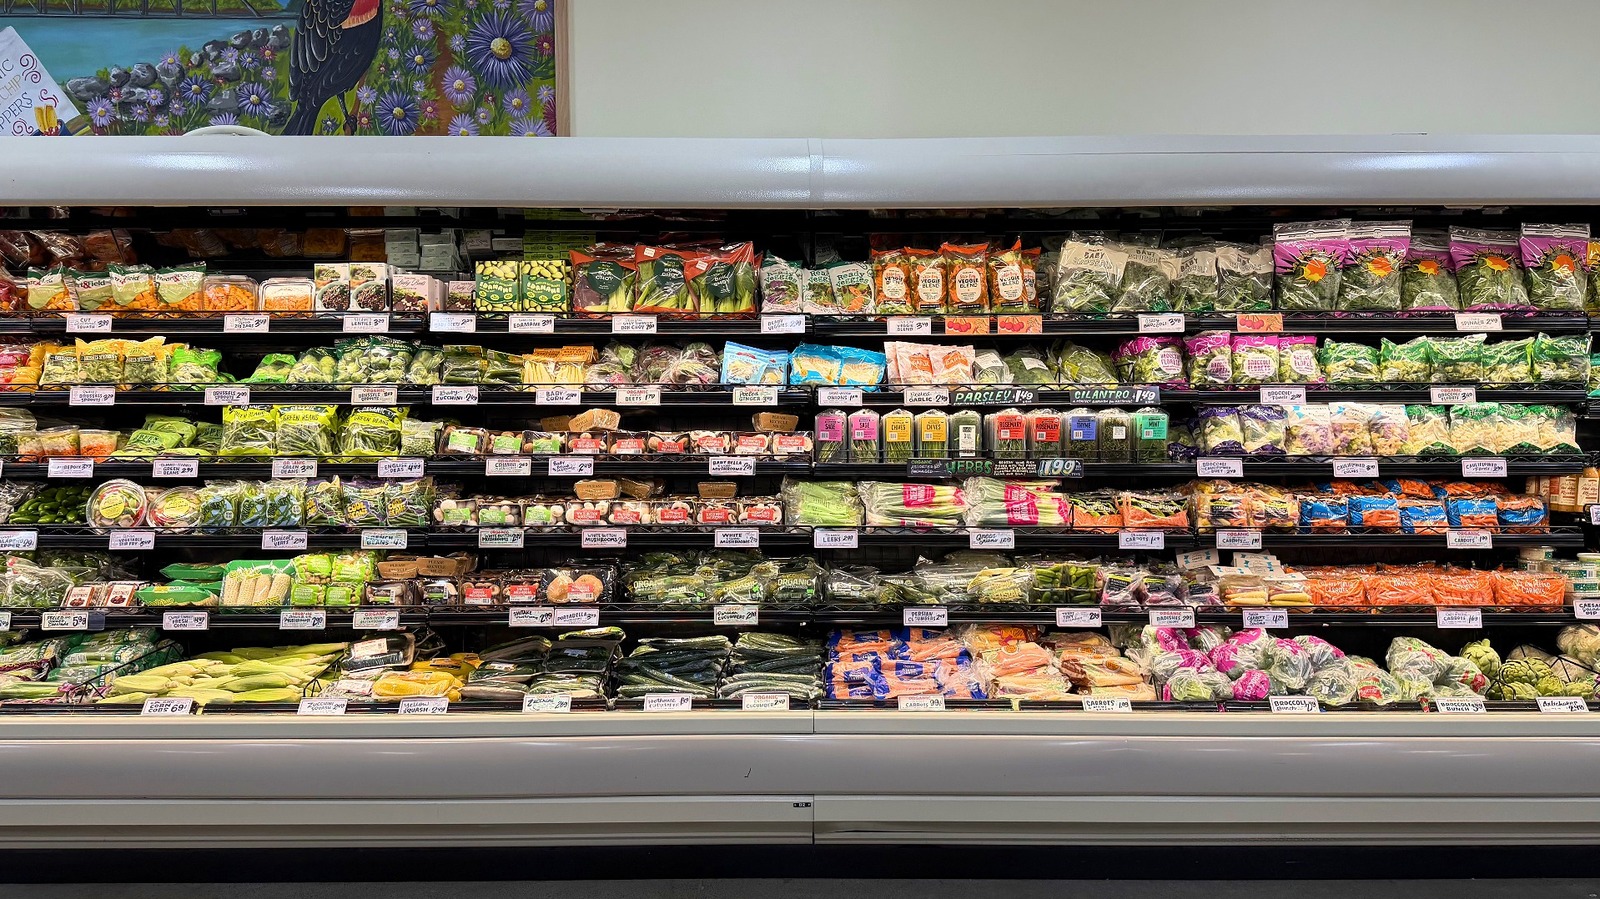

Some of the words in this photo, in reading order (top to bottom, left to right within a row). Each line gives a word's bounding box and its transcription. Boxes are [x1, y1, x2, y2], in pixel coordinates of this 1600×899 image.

[1181, 257, 1198, 273] BABY
[955, 390, 1011, 402] PARSLEY
[1074, 390, 1130, 400] CILANTRO
[372, 417, 389, 425] BEANS
[384, 462, 407, 470] ENGLISH
[946, 460, 993, 475] HERBS
